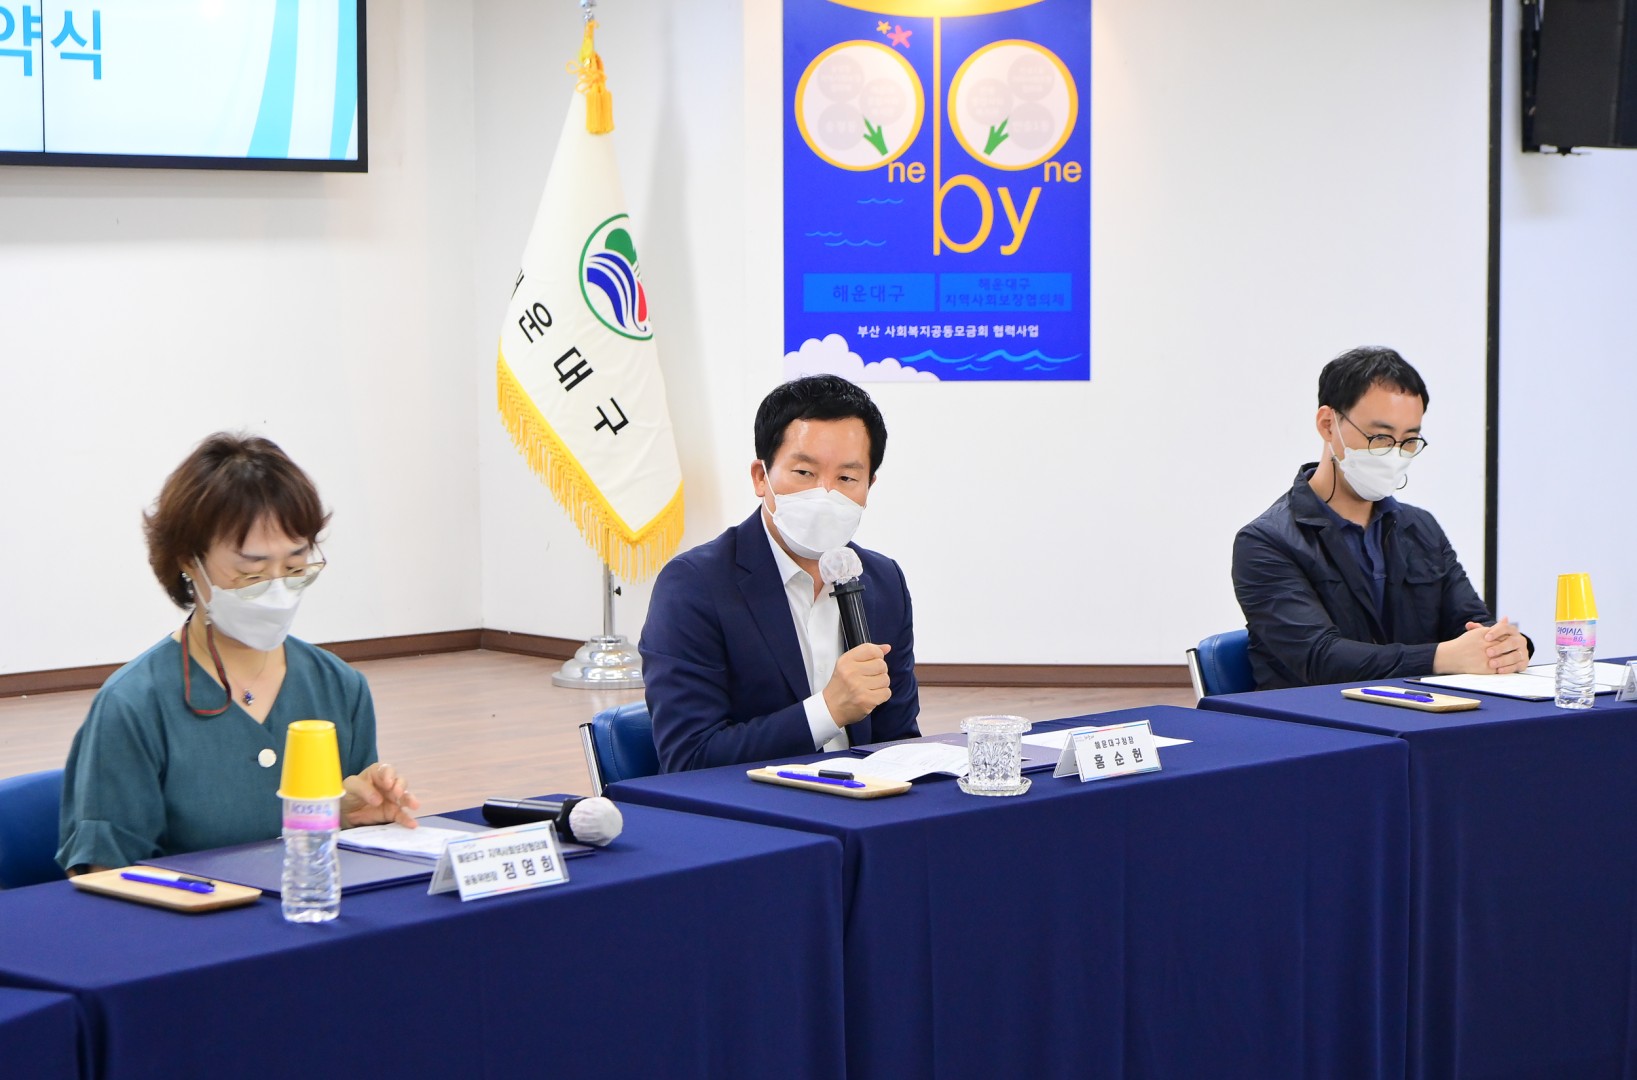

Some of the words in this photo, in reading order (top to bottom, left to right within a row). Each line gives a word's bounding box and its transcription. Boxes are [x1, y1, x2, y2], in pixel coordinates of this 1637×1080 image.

[0, 4, 102, 80] 약식
[977, 277, 1031, 291] 해운대구
[832, 284, 906, 303] 해운대구
[857, 325, 880, 338] 부산
[884, 325, 989, 338] 사회복지공동모금회
[993, 325, 1039, 338] 협력사업
[511, 268, 630, 436] 운대구
[1094, 736, 1135, 750] 해운대구청장
